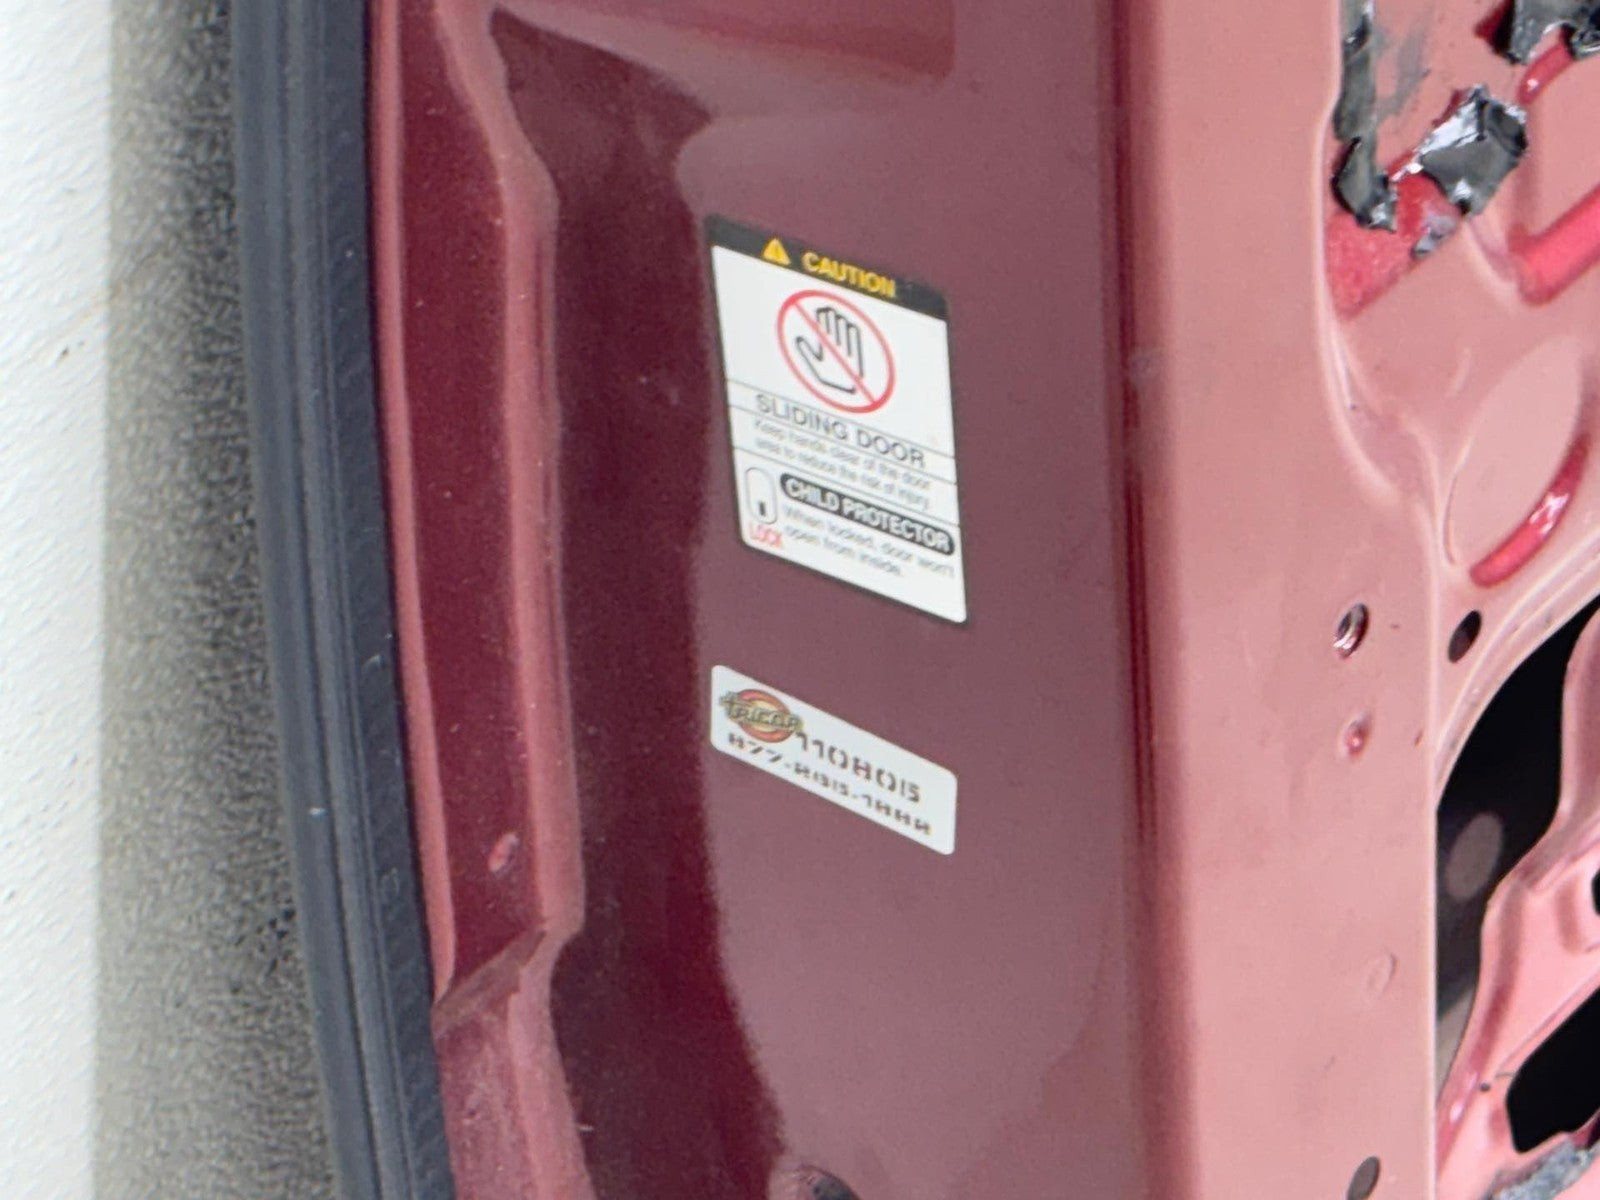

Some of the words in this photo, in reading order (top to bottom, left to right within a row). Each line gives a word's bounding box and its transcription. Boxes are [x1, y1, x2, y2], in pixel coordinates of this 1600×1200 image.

[802, 252, 895, 297] CAUTION
[756, 394, 847, 440] SLIDING
[857, 429, 924, 468] DOOR
[749, 523, 783, 549] LOCK
[786, 478, 840, 512] CHILD
[842, 498, 951, 553] PROTECTOR
[881, 542, 912, 561] door
